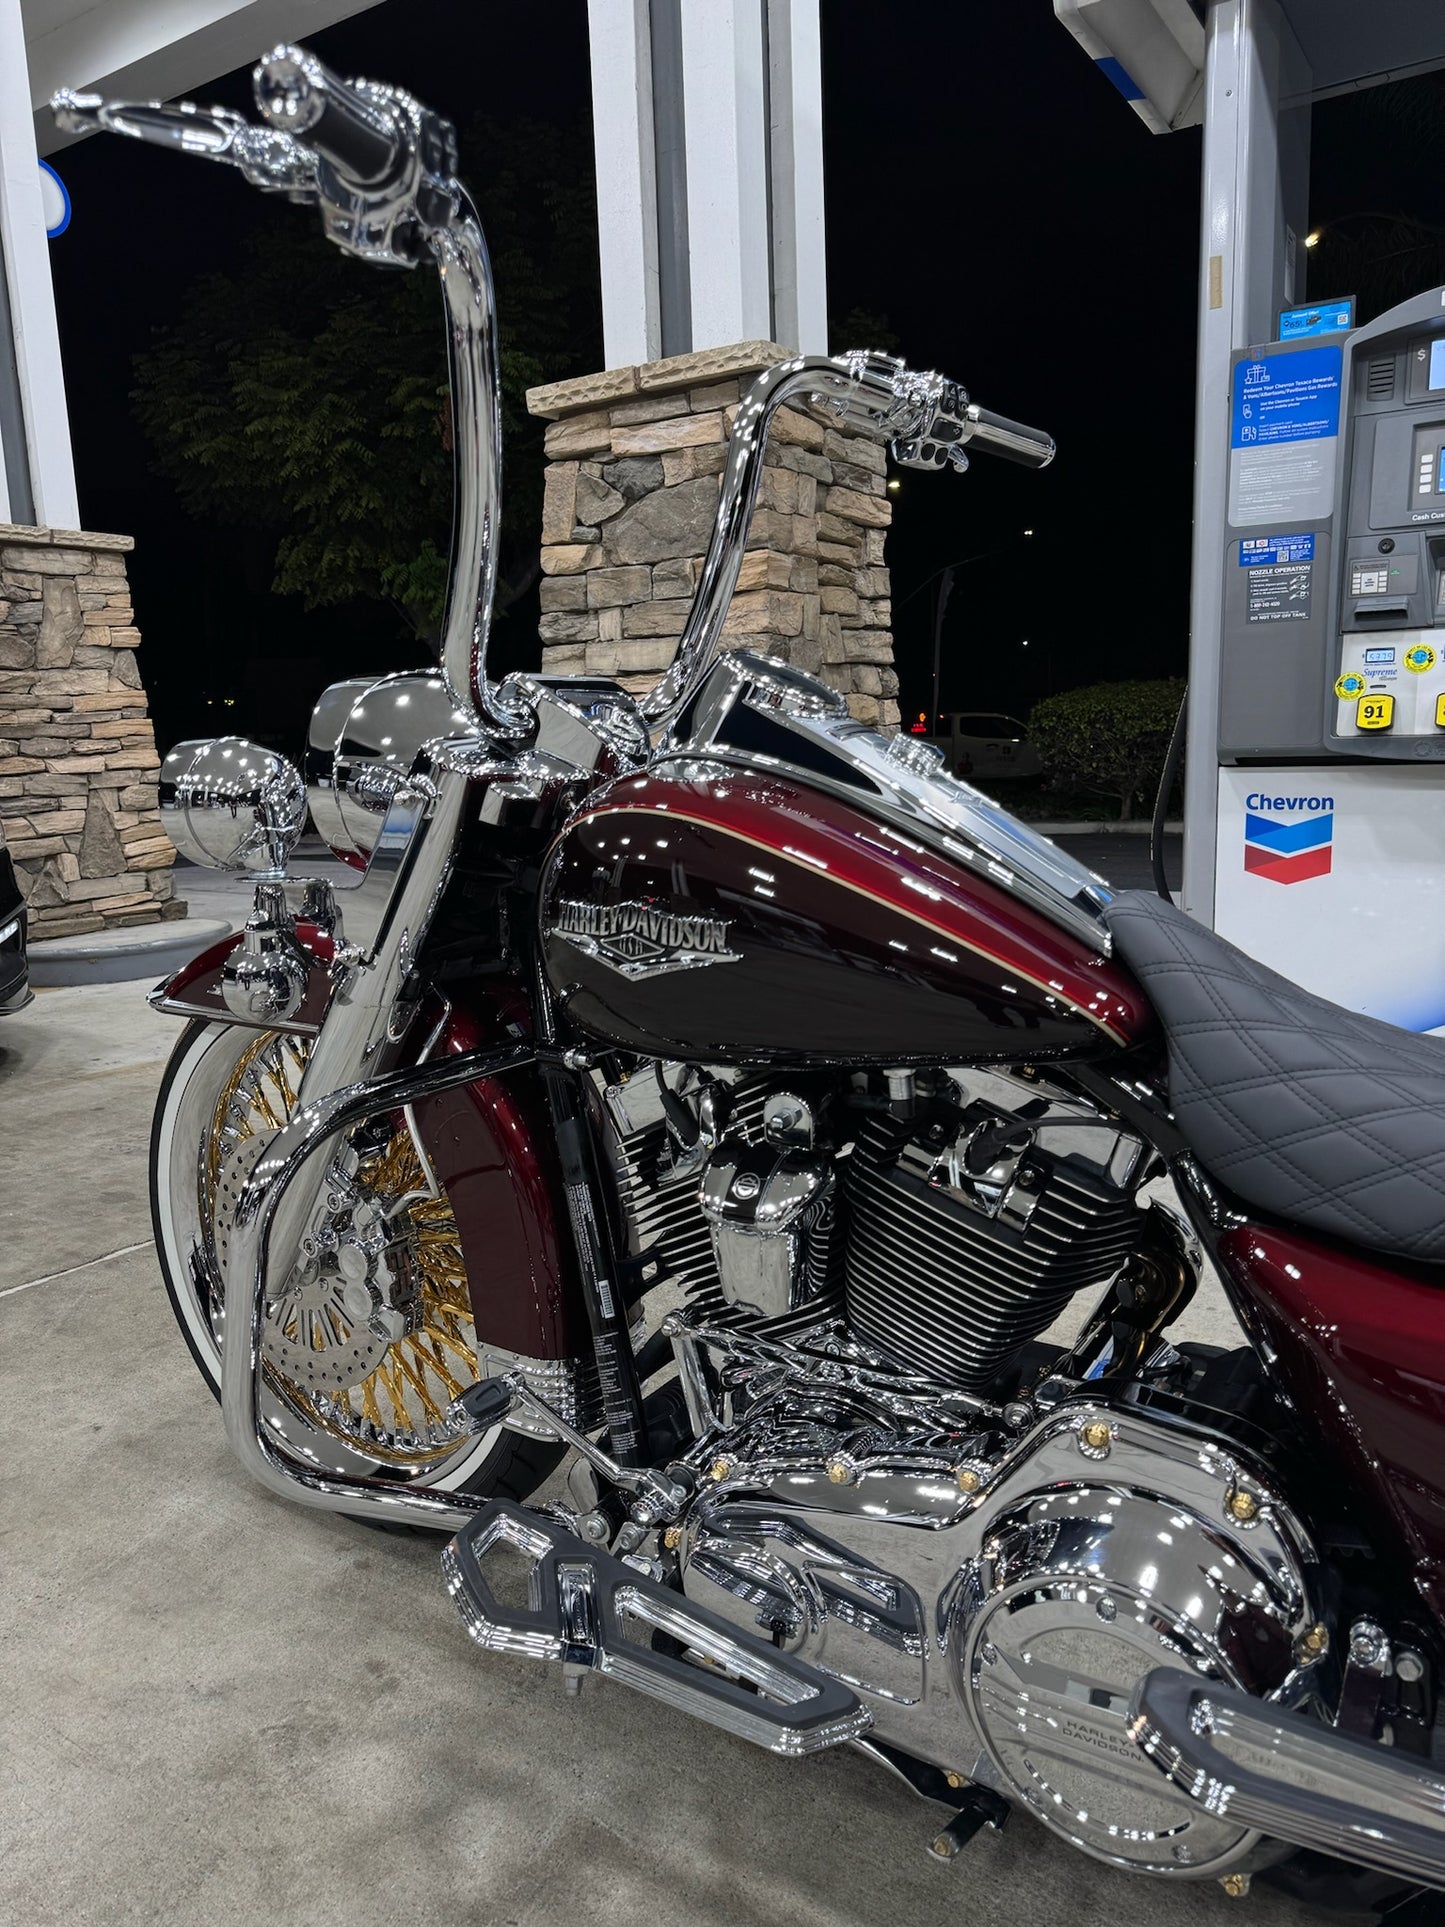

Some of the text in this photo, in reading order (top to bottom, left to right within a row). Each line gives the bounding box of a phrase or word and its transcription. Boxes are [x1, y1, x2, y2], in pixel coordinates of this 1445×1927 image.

[1417, 348, 1426, 362] $
[1243, 386, 1263, 394] Redeem
[1275, 382, 1295, 390] Chevron
[1412, 513, 1430, 521] Cash
[1274, 565, 1311, 574] OPERATION
[1363, 668, 1398, 678] Supreme
[1364, 705, 1384, 719] 91
[1246, 793, 1334, 811] Chevron
[619, 936, 644, 955] USA
